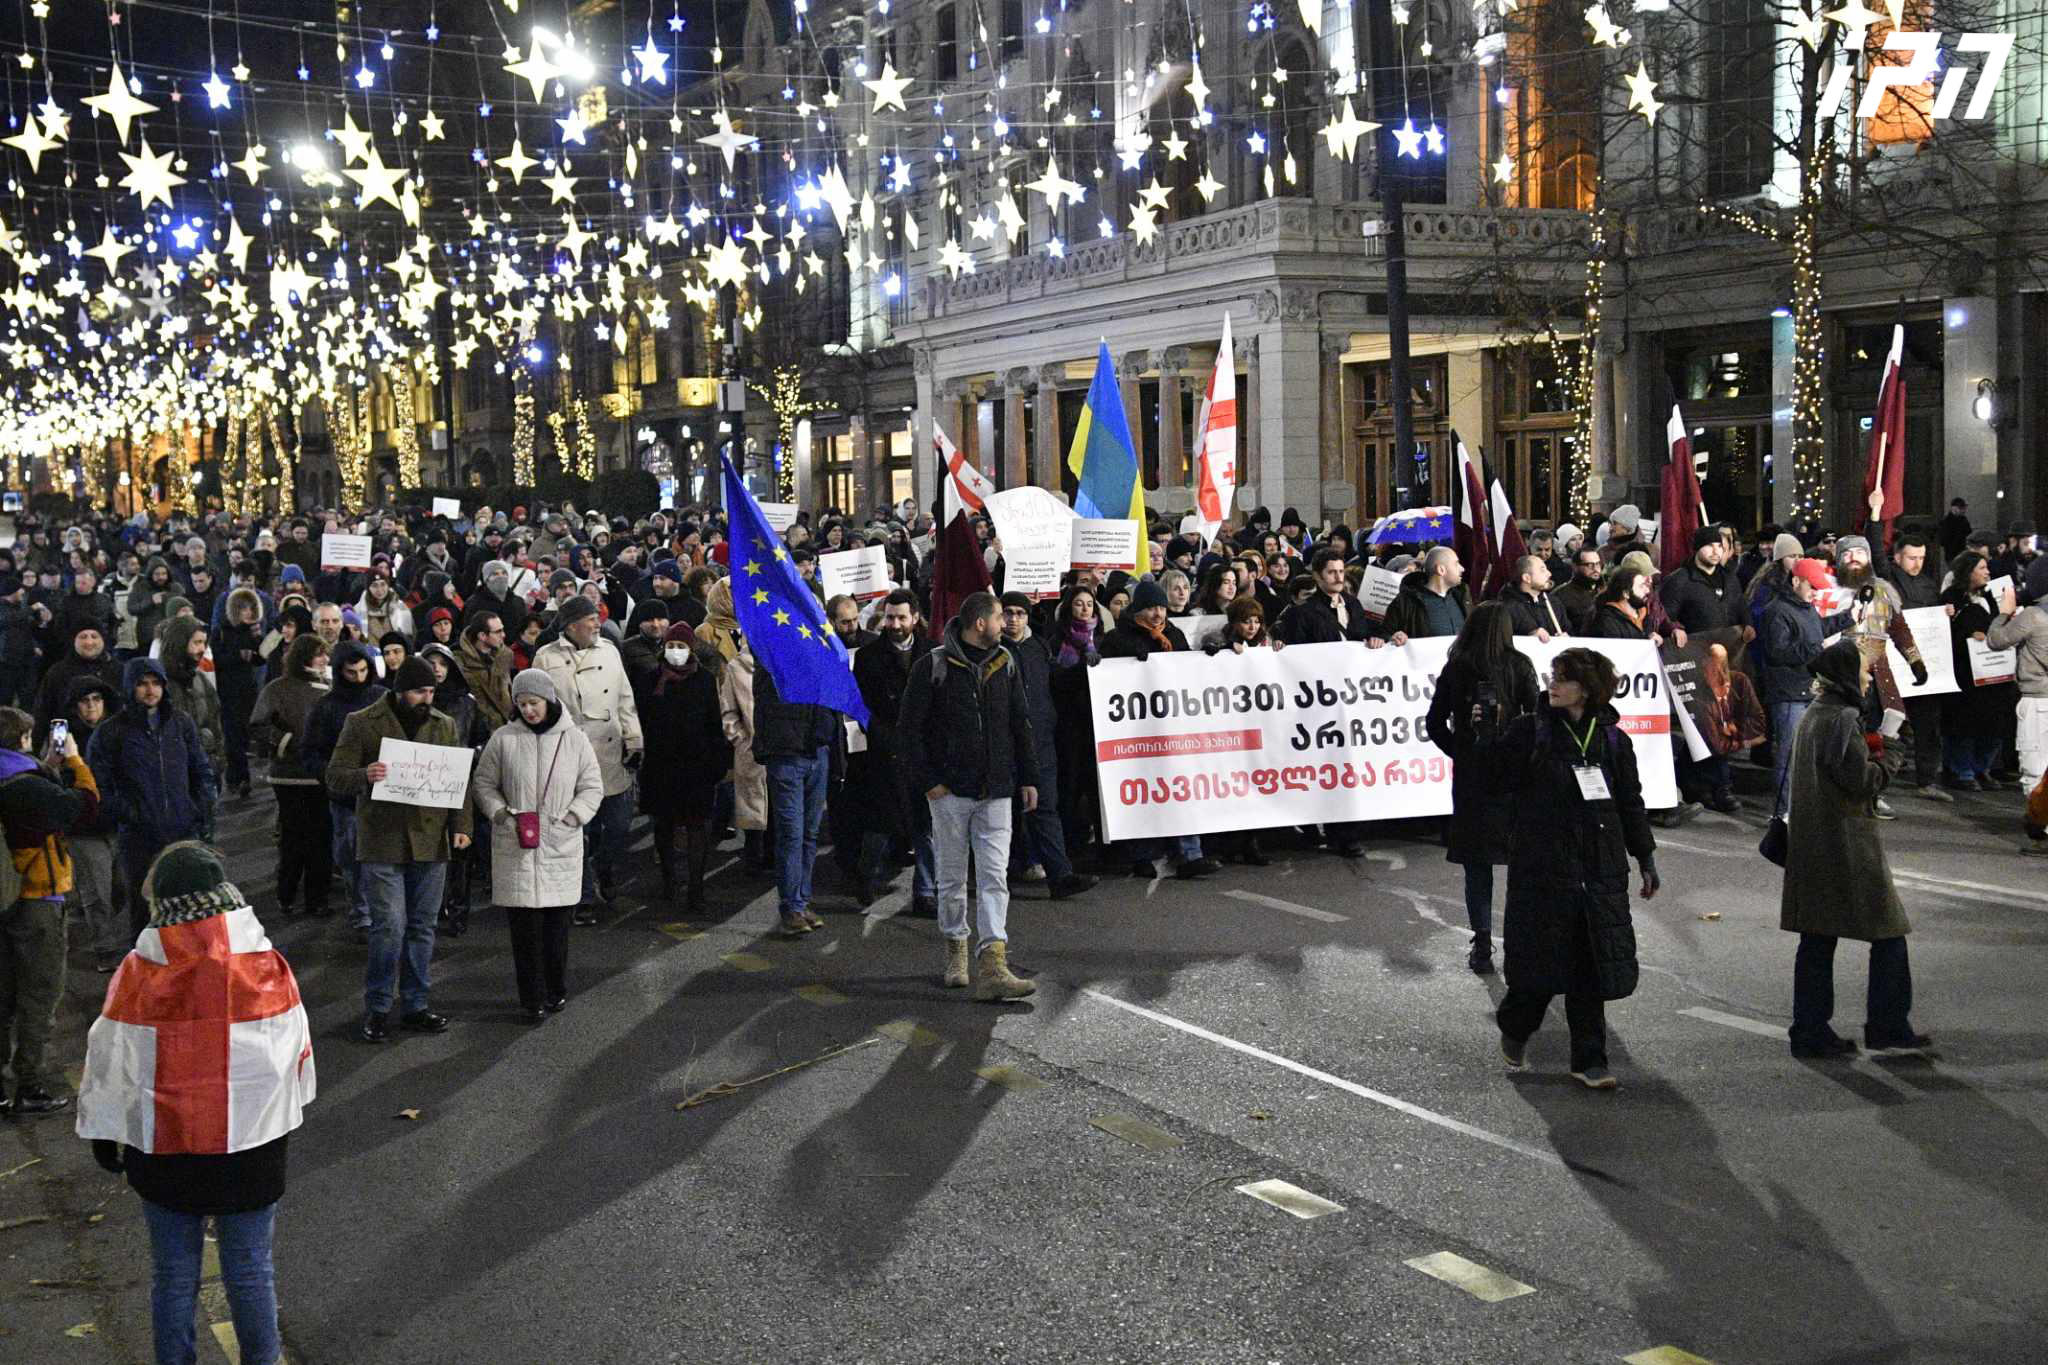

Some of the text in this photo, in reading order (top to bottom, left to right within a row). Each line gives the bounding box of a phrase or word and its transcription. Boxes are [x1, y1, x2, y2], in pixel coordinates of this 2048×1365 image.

[1108, 682, 1286, 722] ვითხოვთ
[1294, 675, 1394, 709] ახალ
[1291, 716, 1433, 751] არჩევნ
[1119, 755, 1453, 806] თავისუფლება რეჟ
